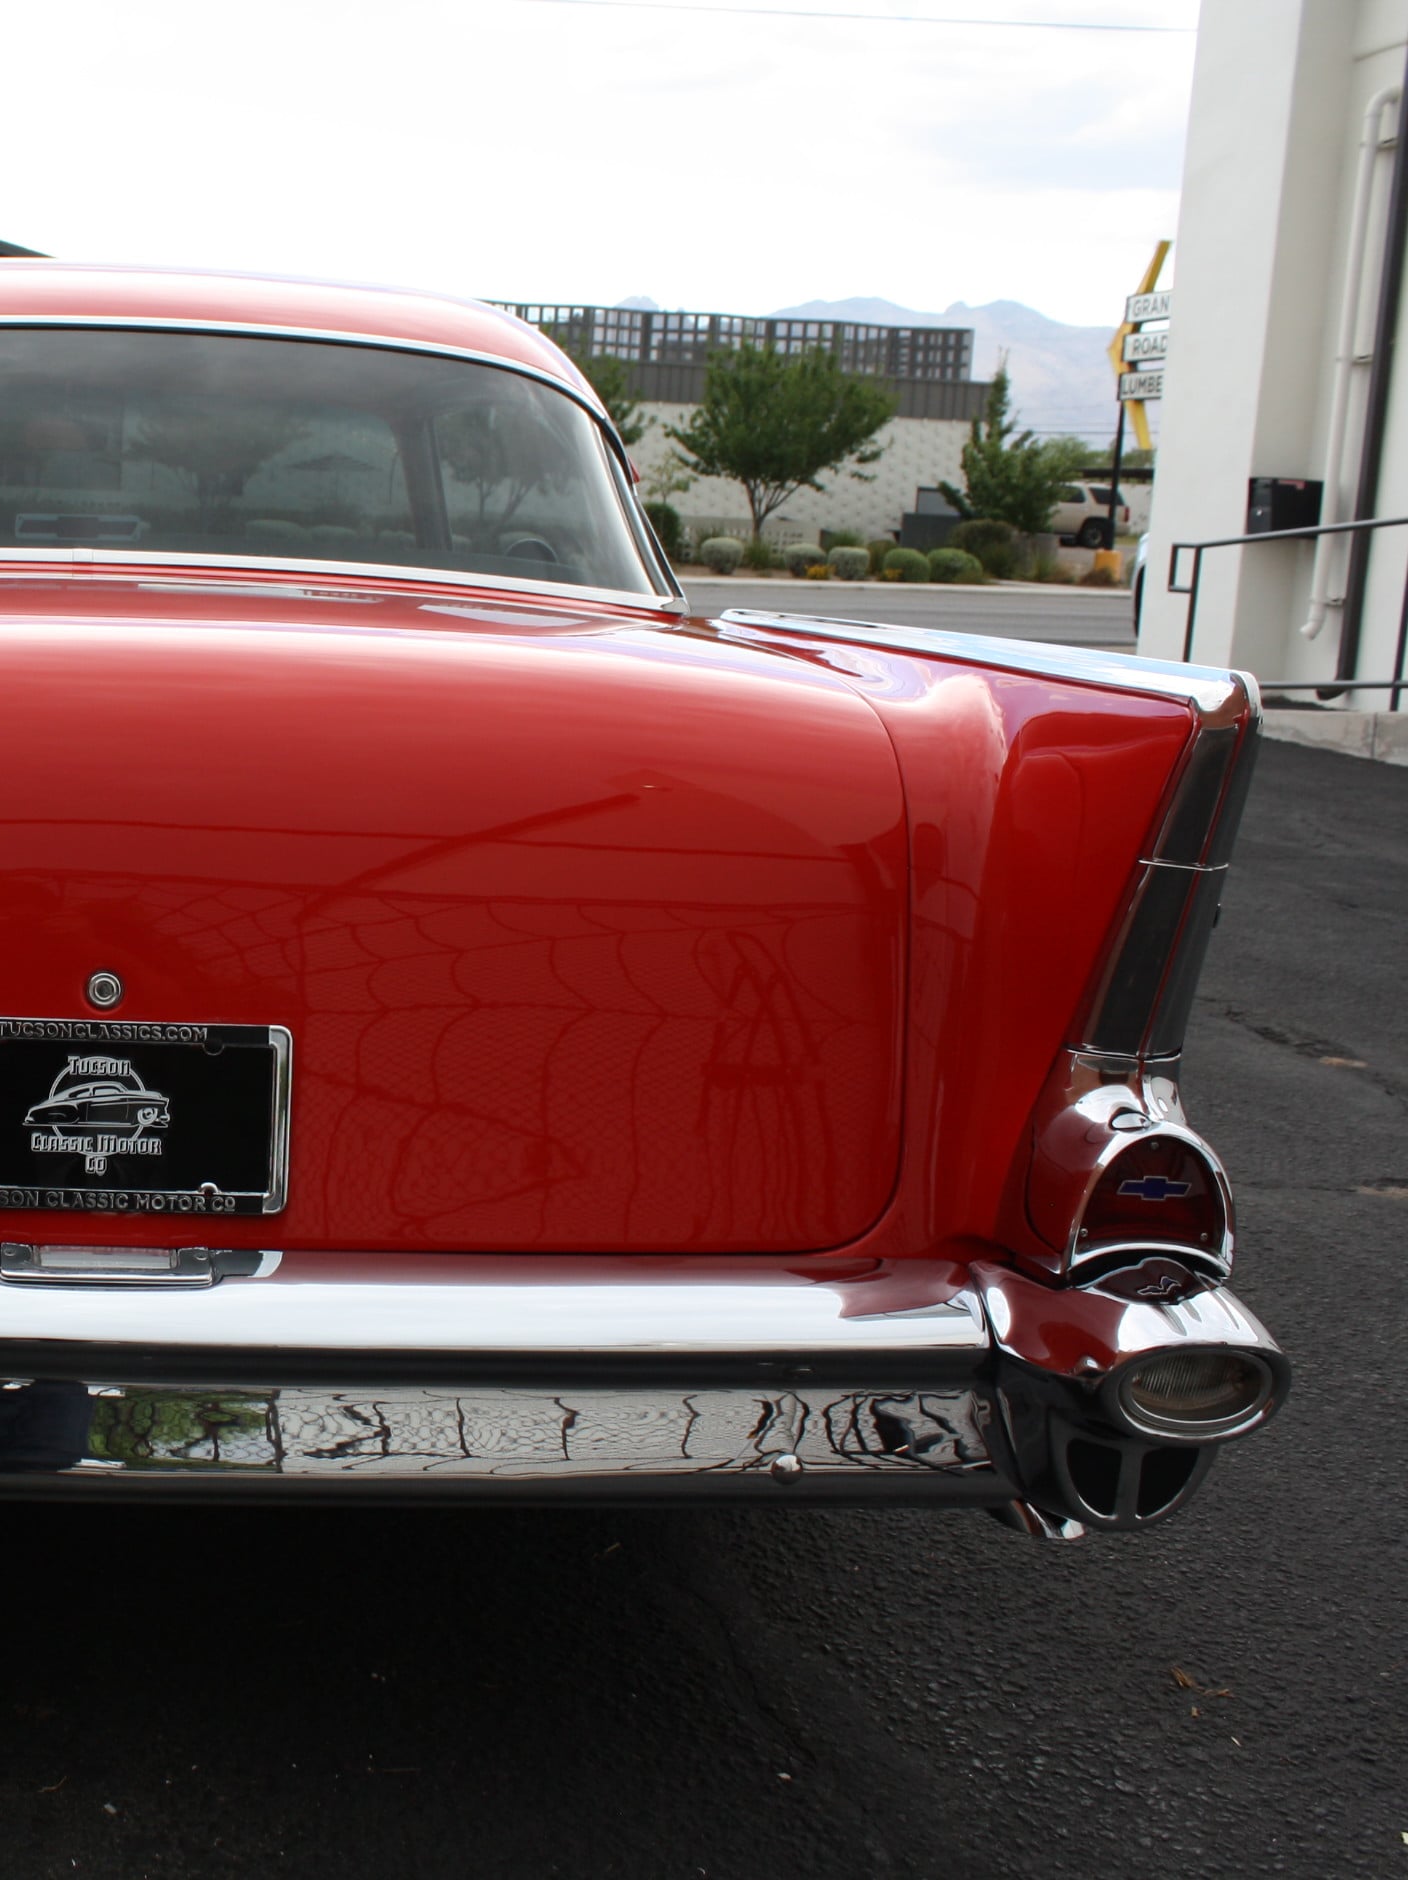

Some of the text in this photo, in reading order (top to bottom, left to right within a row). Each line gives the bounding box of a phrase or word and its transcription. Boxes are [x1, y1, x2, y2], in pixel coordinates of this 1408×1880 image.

[1132, 295, 1170, 318] GRAN
[1131, 335, 1168, 356] ROAD
[1121, 375, 1163, 395] LUMBE
[45, 1190, 129, 1210] CLASSIC
[133, 1193, 207, 1212] MOTOR
